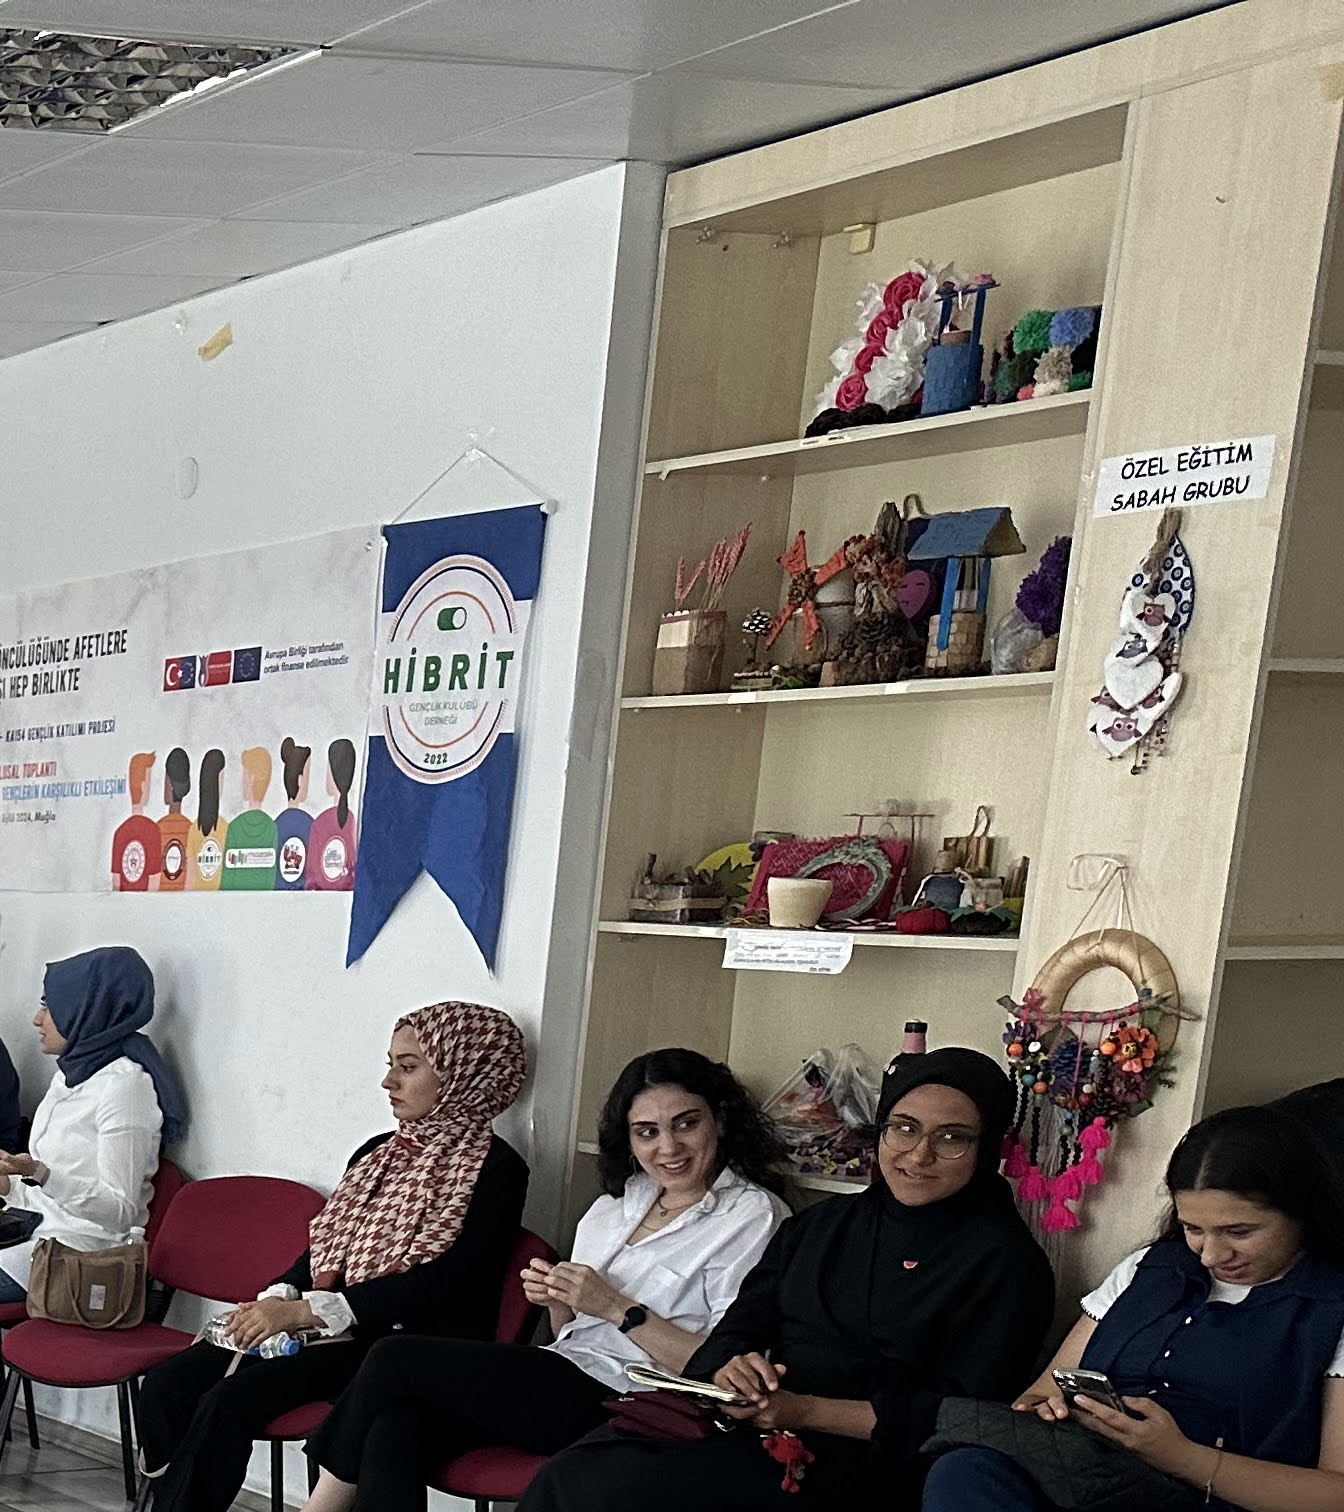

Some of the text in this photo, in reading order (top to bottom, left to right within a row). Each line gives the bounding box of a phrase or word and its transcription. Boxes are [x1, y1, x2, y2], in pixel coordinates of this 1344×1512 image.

[1120, 441, 1253, 480] ÖZEL EĞİTİM
[1111, 475, 1251, 512] SABAH GRUBU
[73, 629, 128, 661] AFETLERE
[9, 674, 29, 698] HEP
[32, 665, 80, 696] BİRLİKTE
[384, 642, 514, 694] HİBRİT
[424, 753, 448, 764] 2022
